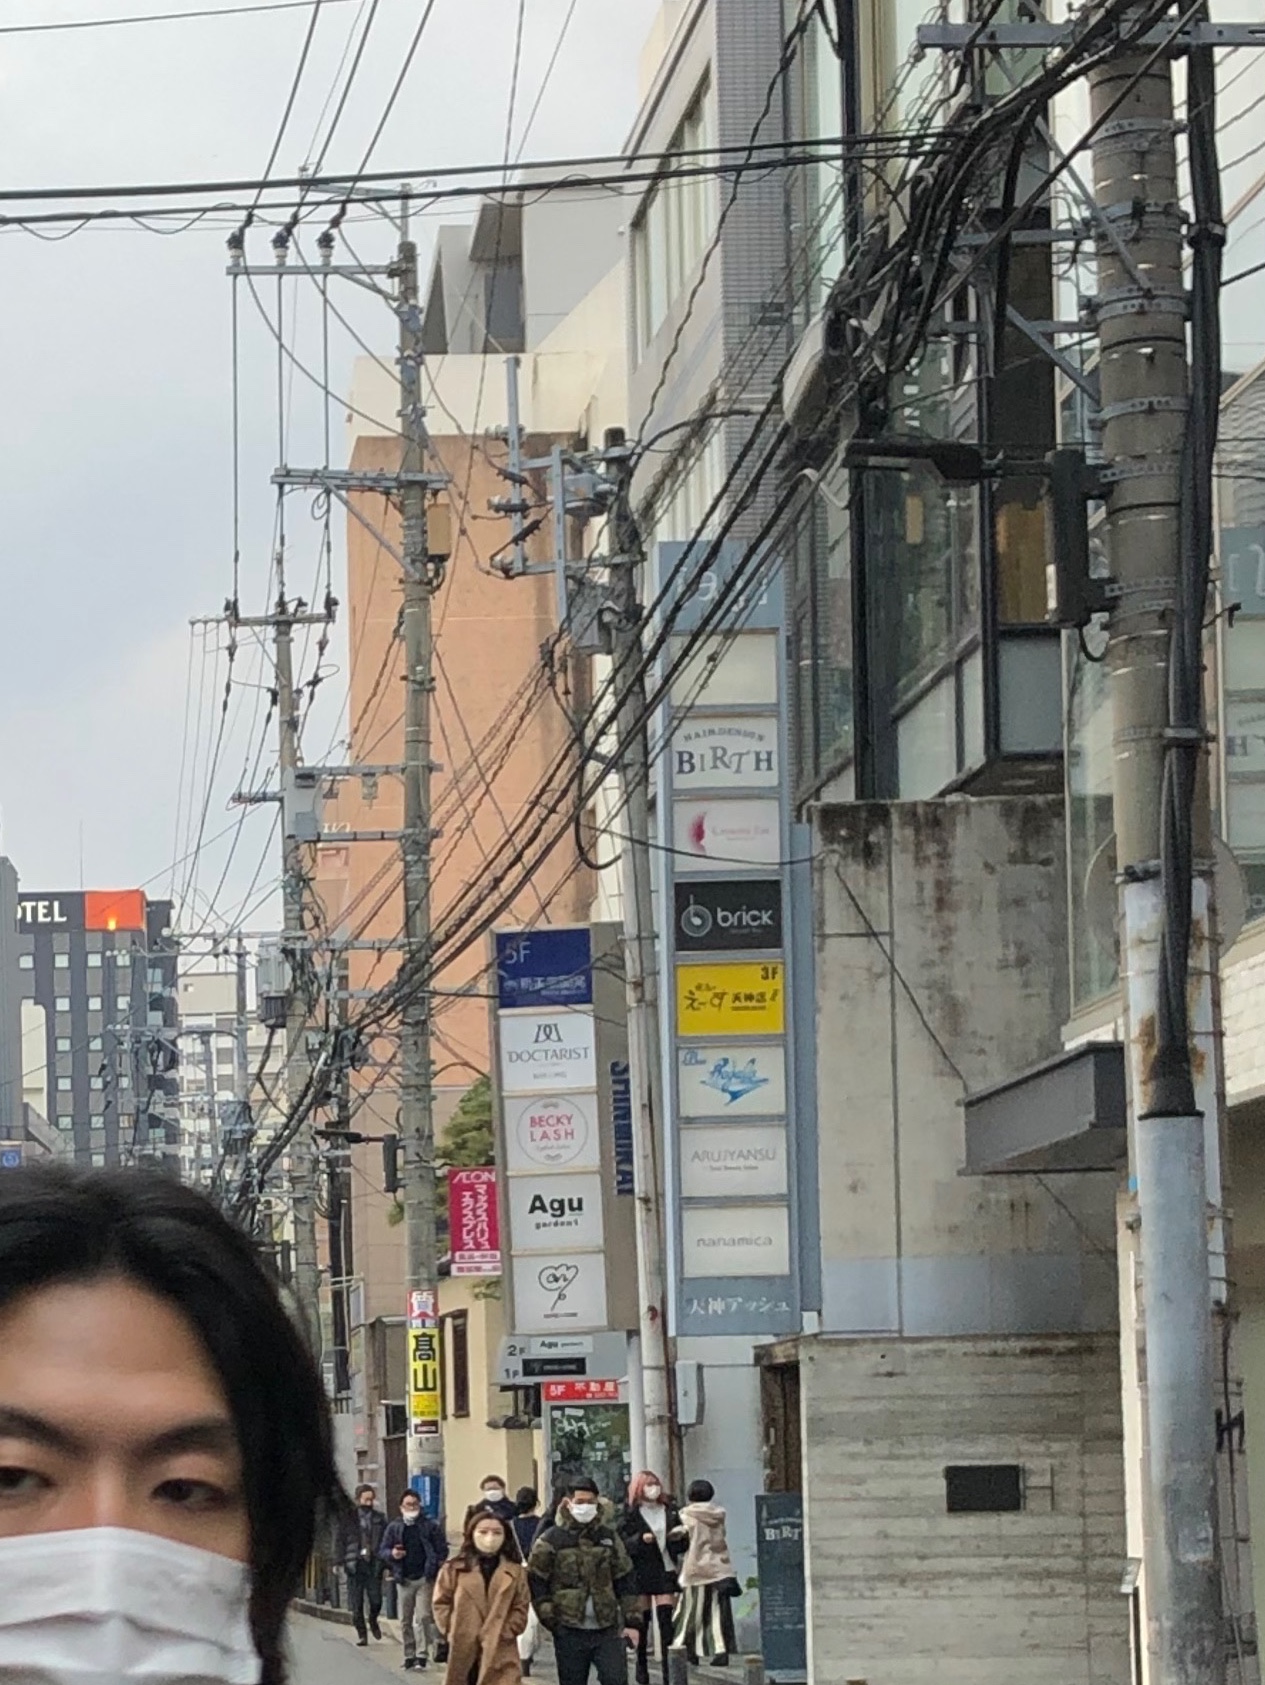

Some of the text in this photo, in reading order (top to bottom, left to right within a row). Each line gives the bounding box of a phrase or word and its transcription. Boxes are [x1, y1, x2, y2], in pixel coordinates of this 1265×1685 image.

[675, 745, 774, 775] BIRTH
[717, 905, 774, 927] brick
[761, 966, 778, 981] 3F
[507, 1046, 590, 1064] DOCTARIST
[529, 1113, 575, 1128] BECKY
[529, 1128, 576, 1142] LASH
[528, 1194, 583, 1218] Agu
[507, 1345, 526, 1357] 2F
[504, 1368, 519, 1379] 1F
[764, 1526, 802, 1541] BIRT
